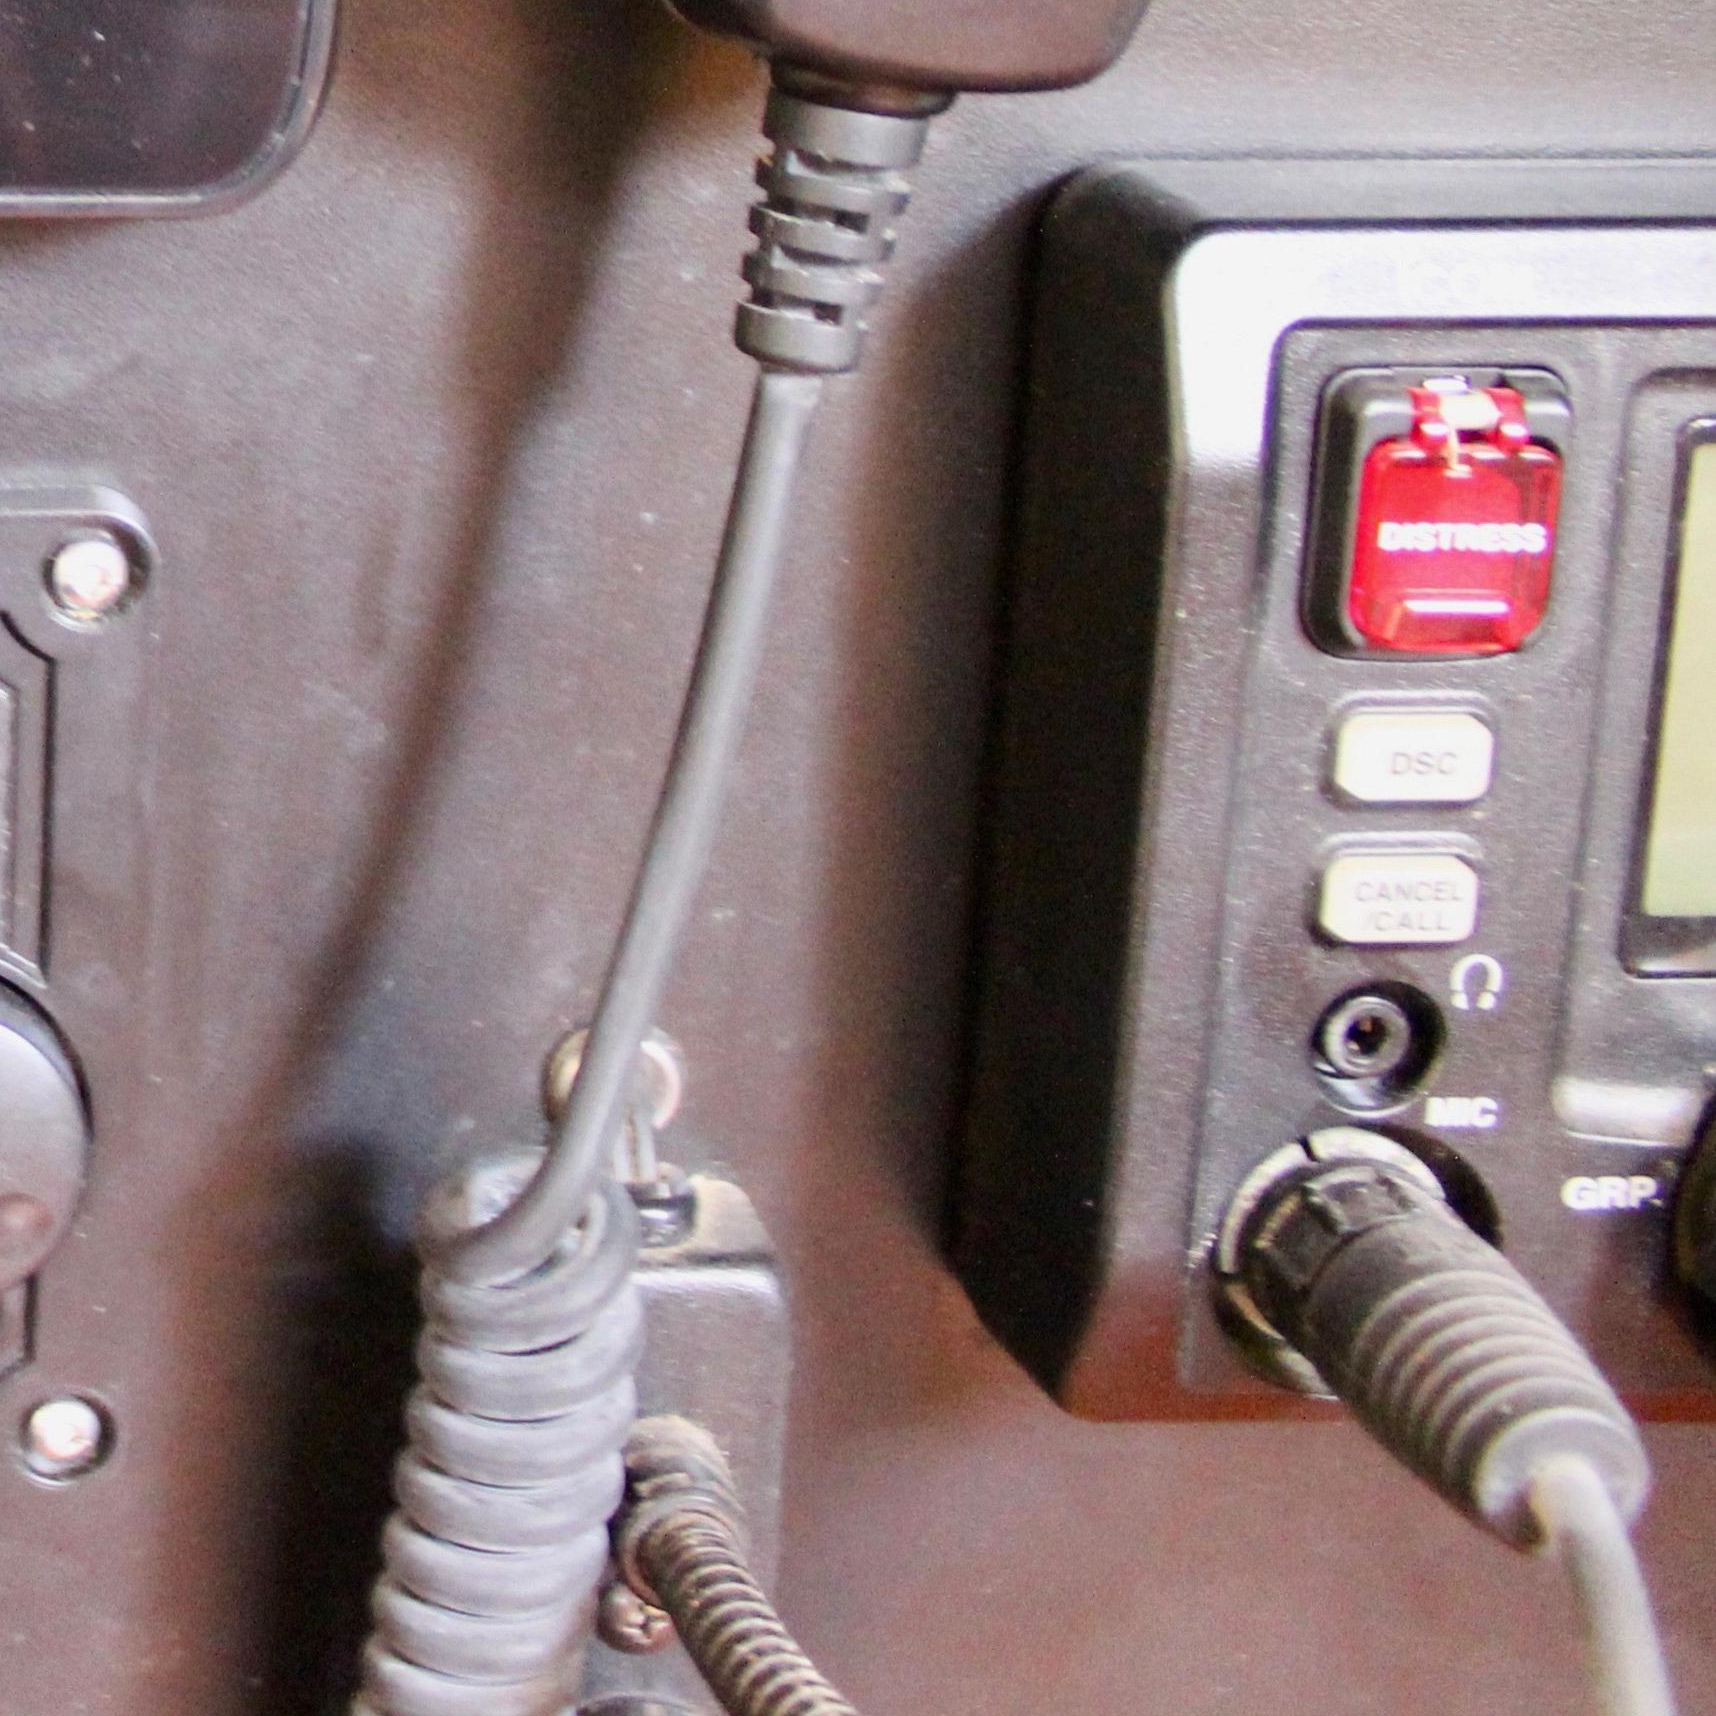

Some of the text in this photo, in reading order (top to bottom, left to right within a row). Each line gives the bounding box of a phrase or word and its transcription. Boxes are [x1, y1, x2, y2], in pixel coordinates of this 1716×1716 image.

[1377, 521, 1547, 554] DISTRESS
[1390, 750, 1458, 775] DSC
[1354, 881, 1463, 902] CANCEL
[1425, 1096, 1498, 1127] MIC
